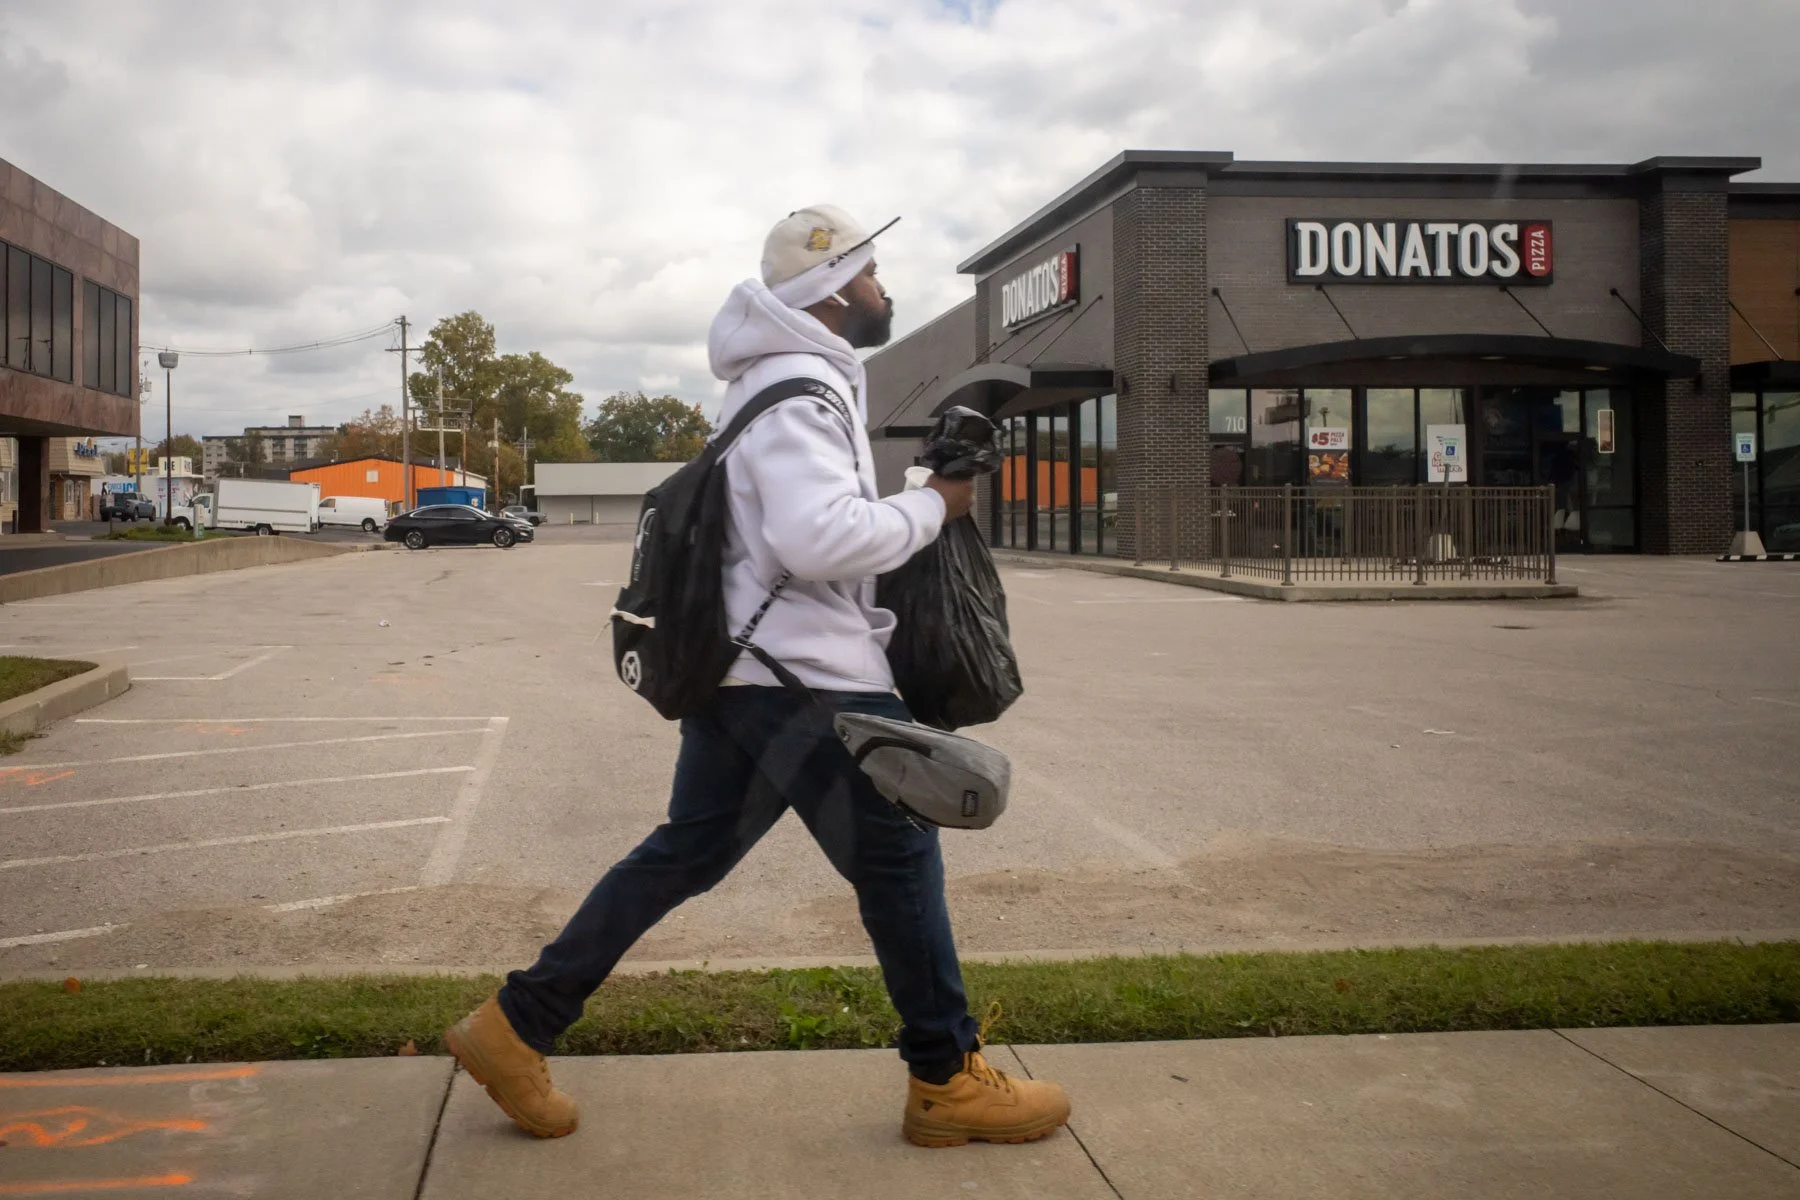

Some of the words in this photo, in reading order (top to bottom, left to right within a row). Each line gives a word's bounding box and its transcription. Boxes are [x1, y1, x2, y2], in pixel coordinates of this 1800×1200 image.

[1295, 222, 1520, 277] DONATOS
[1531, 229, 1545, 271] PIZZA
[1002, 257, 1059, 327] DONATOS
[1225, 416, 1246, 431] 710
[164, 461, 175, 471] IE
